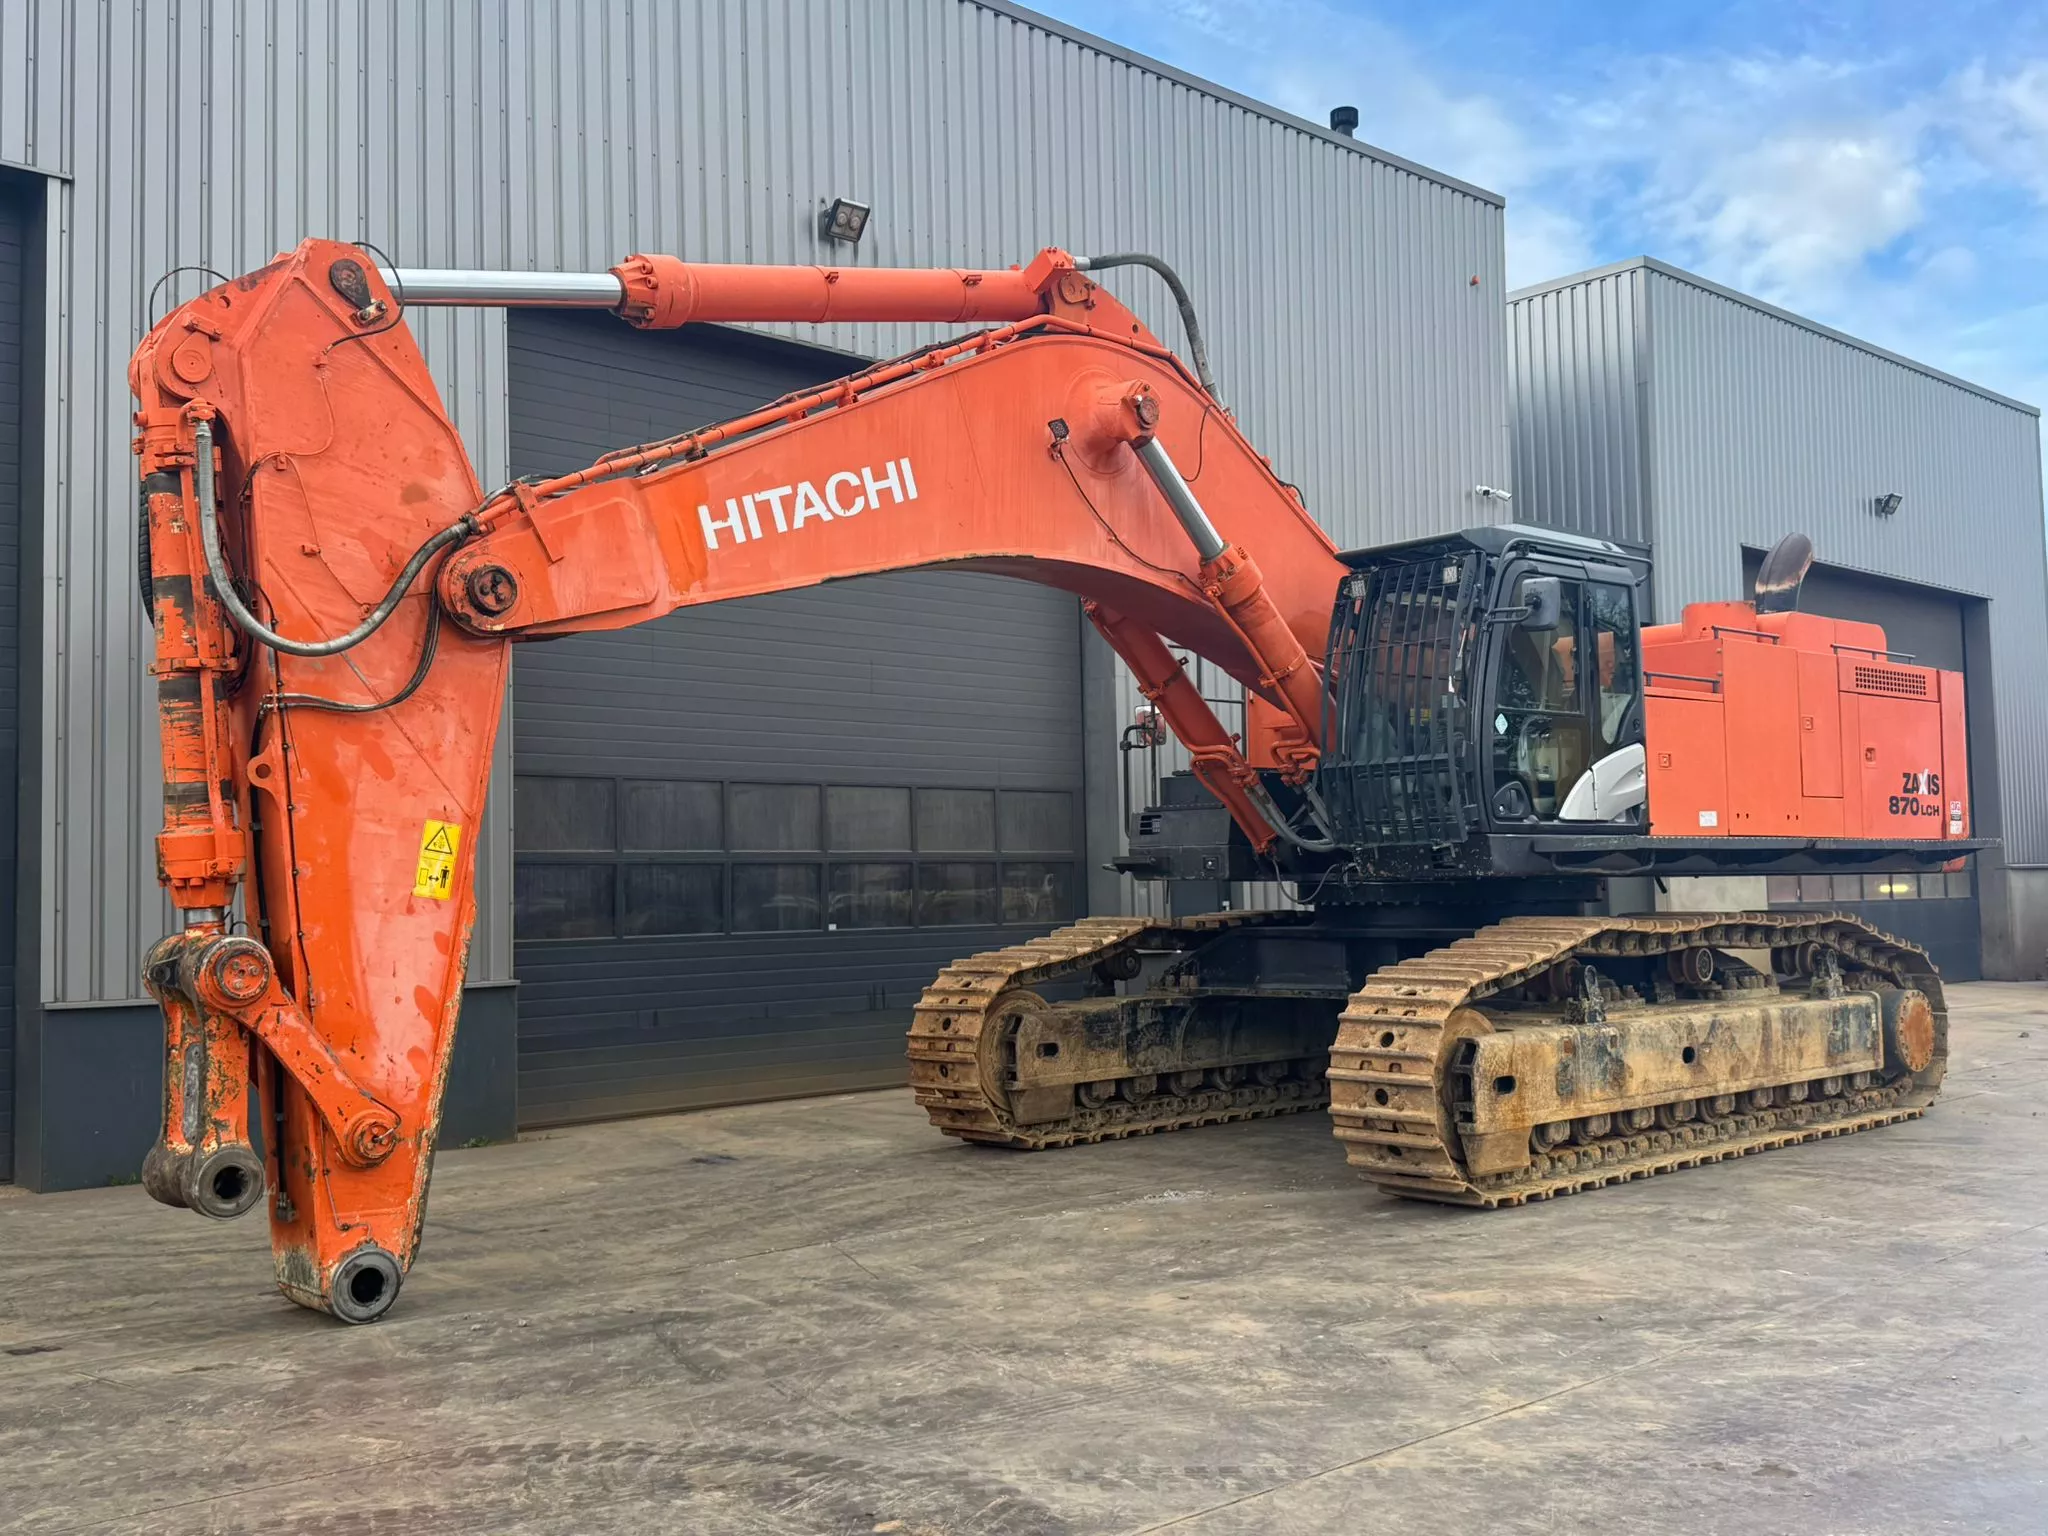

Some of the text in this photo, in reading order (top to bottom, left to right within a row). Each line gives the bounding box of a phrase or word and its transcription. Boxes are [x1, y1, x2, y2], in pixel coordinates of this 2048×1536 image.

[697, 457, 918, 550] HITACHI
[1902, 768, 1940, 795] ZAXIS
[1888, 795, 1920, 816] 870
[1921, 804, 1940, 816] LCH
